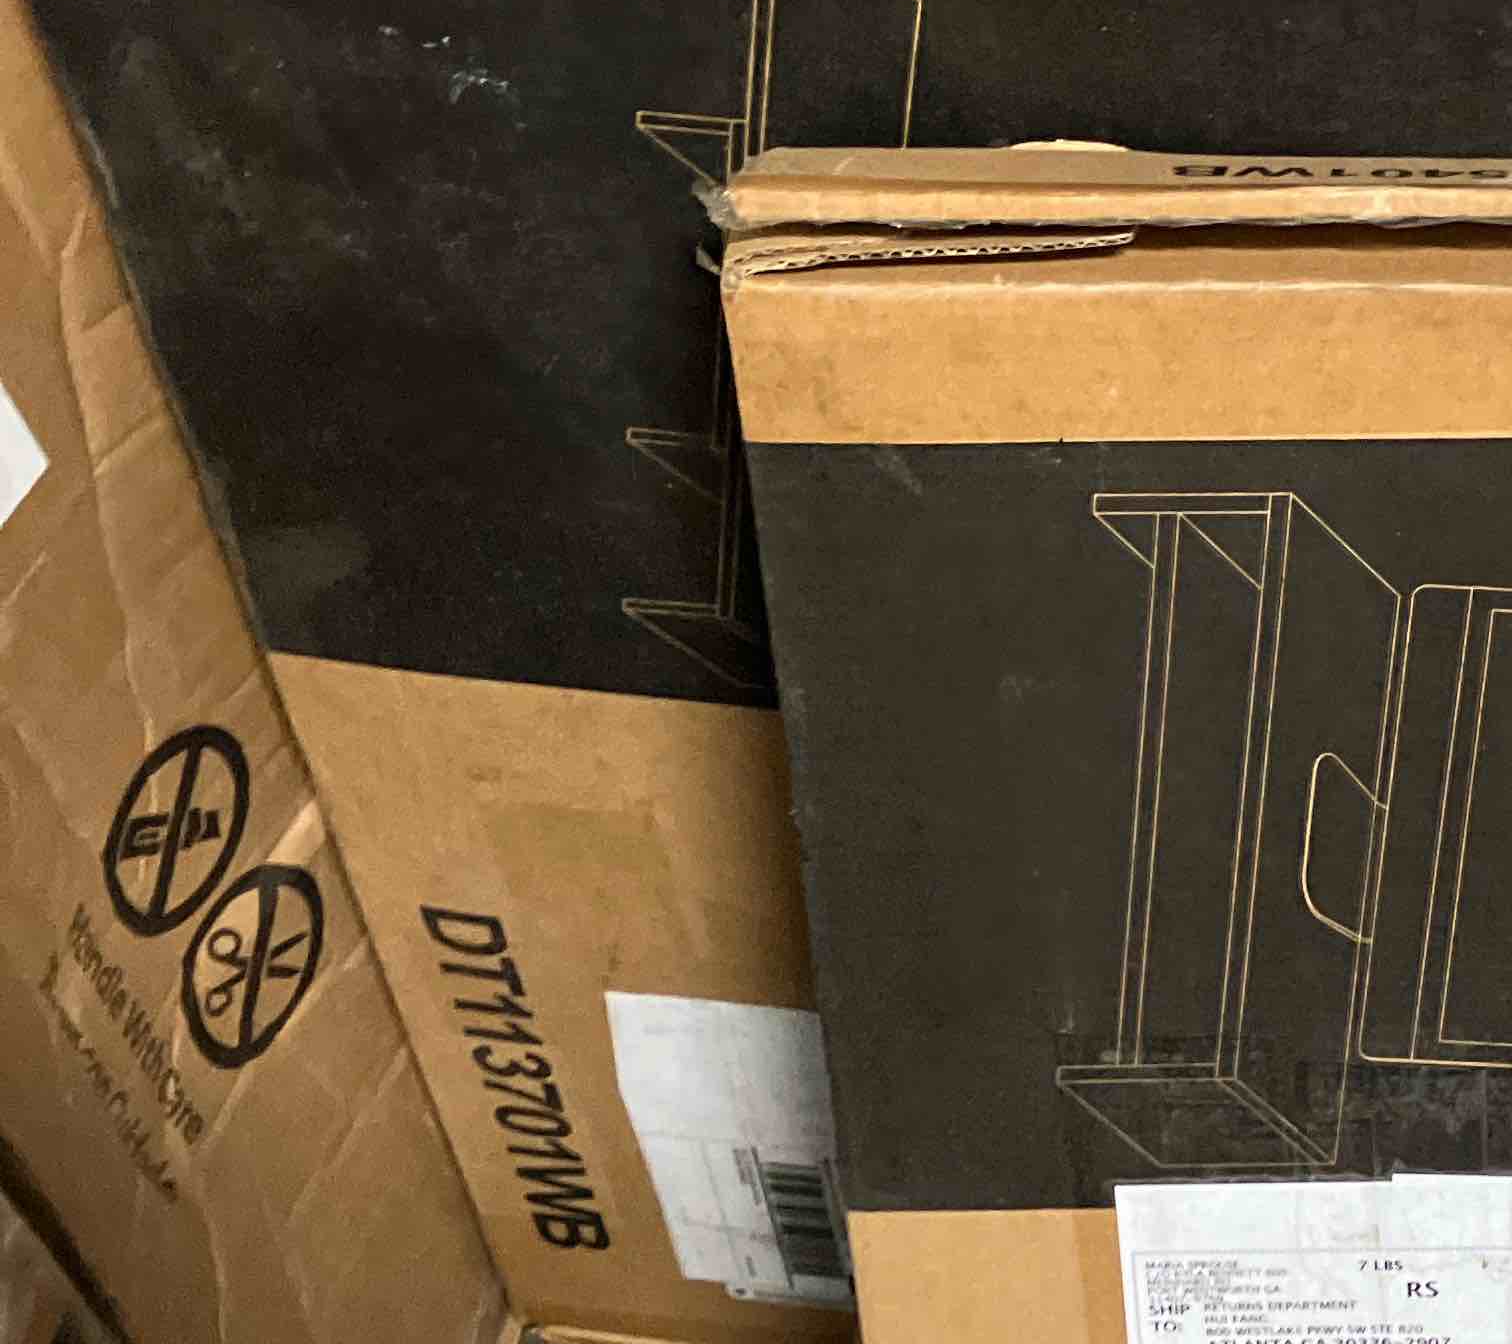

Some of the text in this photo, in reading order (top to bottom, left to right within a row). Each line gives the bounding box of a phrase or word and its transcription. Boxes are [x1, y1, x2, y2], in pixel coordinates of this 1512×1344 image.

[419, 903, 612, 1251] DT113701WB
[1373, 1259, 1404, 1272] LBS
[1406, 1280, 1440, 1299] RS
[1148, 1305, 1192, 1317] SHIP
[1268, 1299, 1358, 1312] DEPARTMENT
